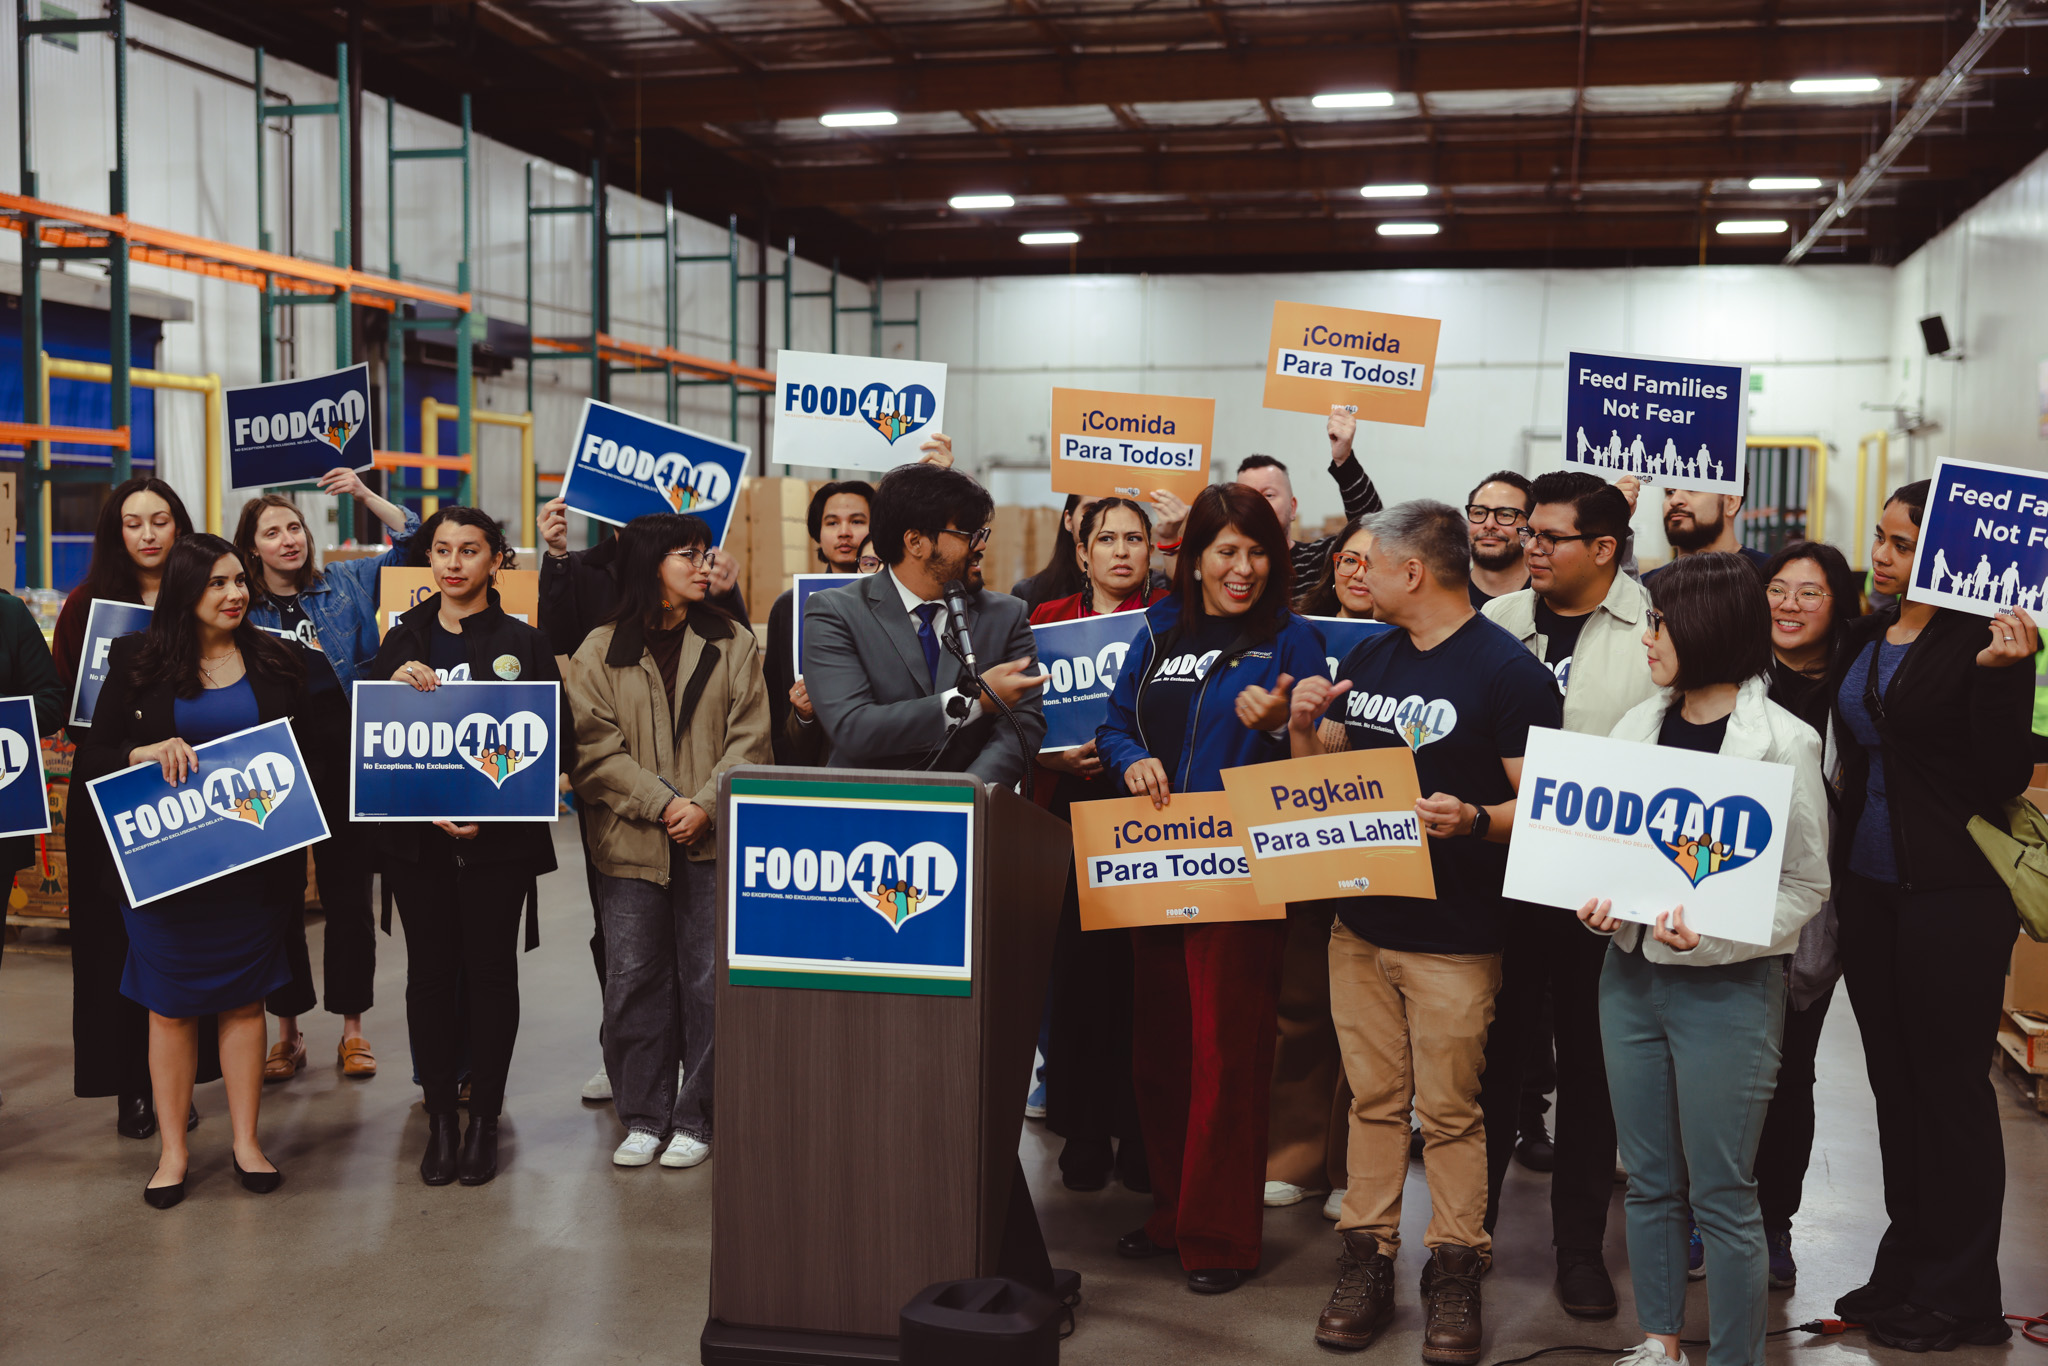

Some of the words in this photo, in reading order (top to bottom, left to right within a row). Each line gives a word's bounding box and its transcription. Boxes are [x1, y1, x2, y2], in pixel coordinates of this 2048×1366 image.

[1303, 326, 1400, 353] ¡Comida
[1283, 353, 1332, 377] Para
[1341, 360, 1416, 386] Todos!
[1580, 368, 1627, 390] Feed
[1634, 375, 1728, 399] Families
[786, 383, 927, 423] FOOD4ALL
[1603, 398, 1639, 419] Not
[1646, 403, 1695, 424] Fear
[235, 399, 361, 445] FOOD4ALL
[1082, 411, 1175, 435] ¡Comida
[1066, 439, 1112, 460] Para
[1119, 444, 1193, 466] Todos!
[1949, 483, 2012, 510] Feed
[1973, 518, 2020, 544] Not
[1073, 692, 1109, 702] Exclusions.
[364, 721, 539, 758] FOOD4ALL
[114, 762, 289, 846] FOOD4ALL
[1271, 775, 1383, 813] Pagkain
[1114, 816, 1233, 848] ¡Comida
[1531, 777, 1756, 857] FOOD4ALL
[1253, 831, 1310, 853] Para
[1316, 826, 1345, 845] sa
[1350, 817, 1418, 843] Lahat!
[745, 847, 945, 896] FOOD4ALL
[1096, 858, 1158, 883] Para
[1166, 855, 1250, 878] Todos
